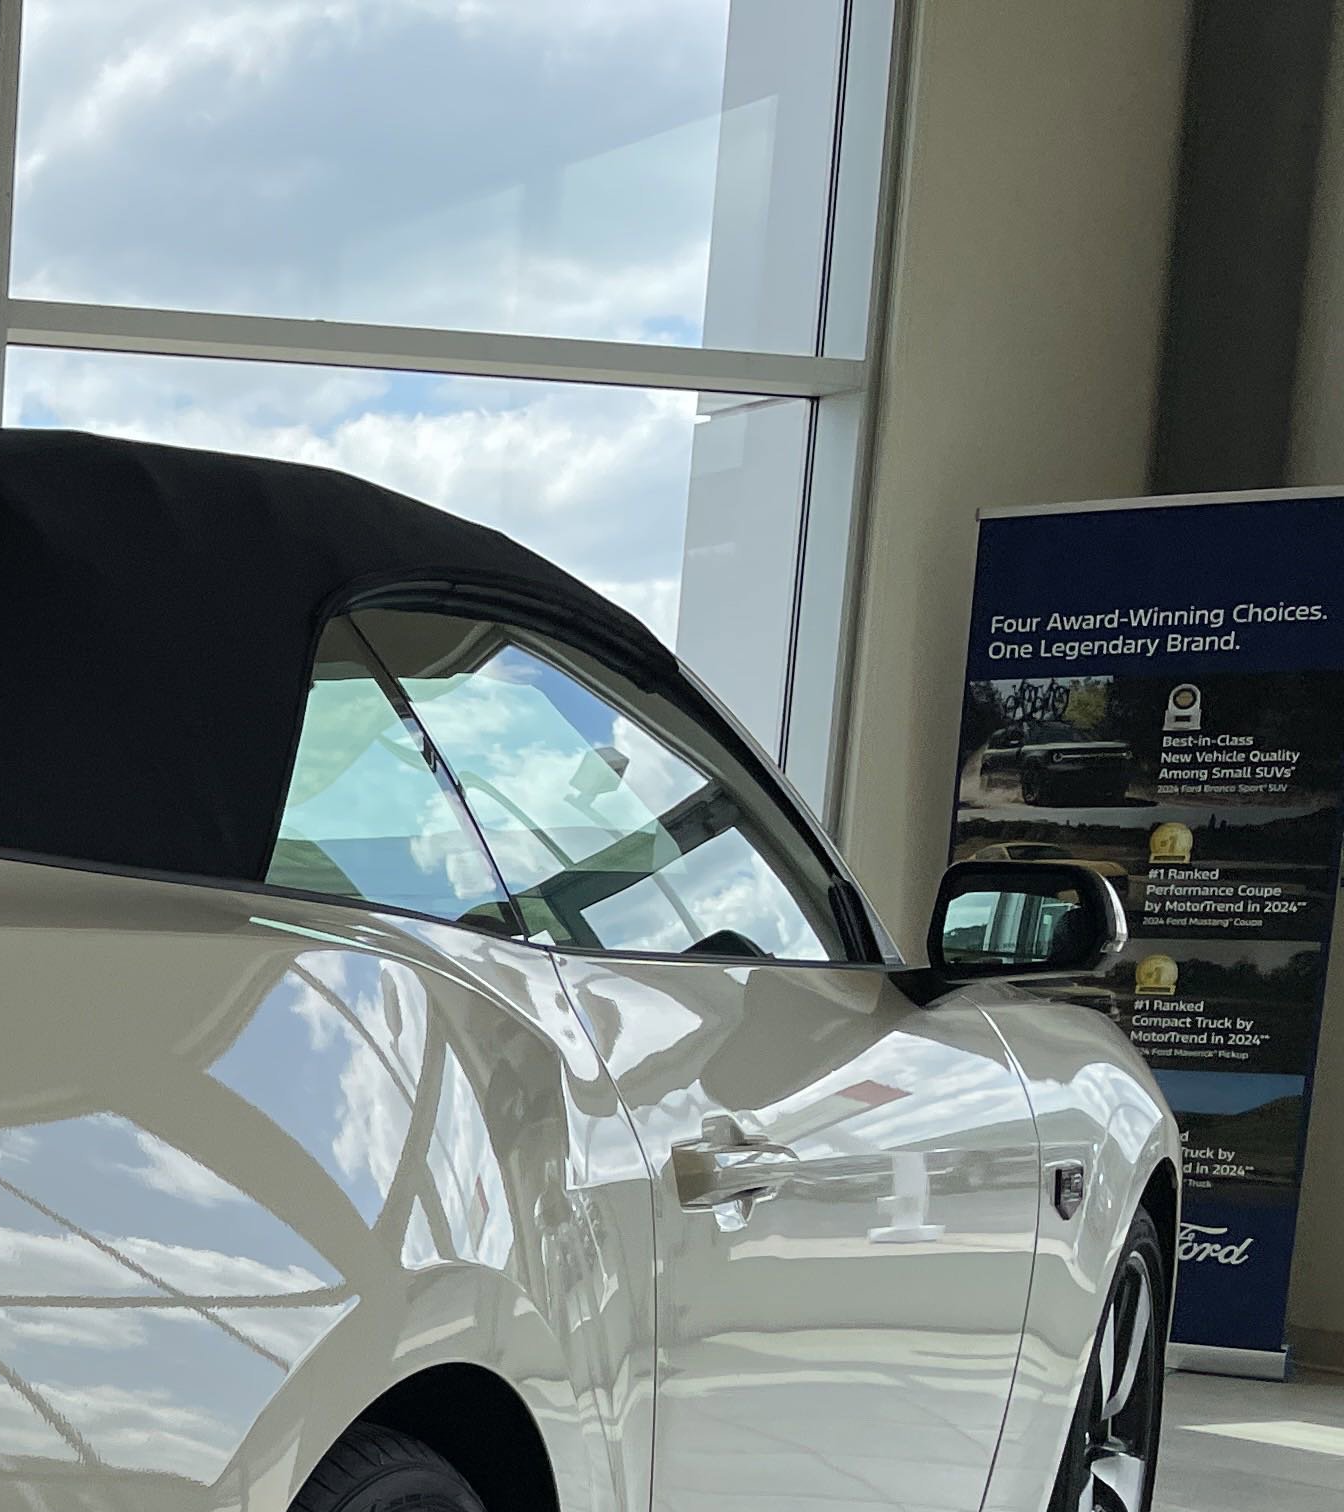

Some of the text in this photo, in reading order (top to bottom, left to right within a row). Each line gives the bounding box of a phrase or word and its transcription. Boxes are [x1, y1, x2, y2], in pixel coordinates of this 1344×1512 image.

[991, 601, 1328, 634] Four Award-Winning Choices.
[988, 631, 1240, 660] One Legendary Brand.
[1163, 735, 1253, 747] Best-in-Class
[1161, 750, 1300, 763] New Vehicle Quality
[1159, 768, 1208, 780] Among
[1212, 767, 1251, 778] Small
[1149, 869, 1219, 880] #1 Ranked
[1146, 885, 1282, 897] Performance Coupe
[1144, 900, 1162, 913] by
[1165, 901, 1243, 912] MotorTrend
[1248, 901, 1260, 912] in
[1134, 1000, 1204, 1012] #1 Ranked
[1132, 1015, 1254, 1031] Compact Truck by
[1130, 1031, 1207, 1044] MotorTrend
[1211, 1032, 1224, 1044] in
[1218, 1148, 1235, 1161] by
[1196, 1162, 1209, 1174] in
